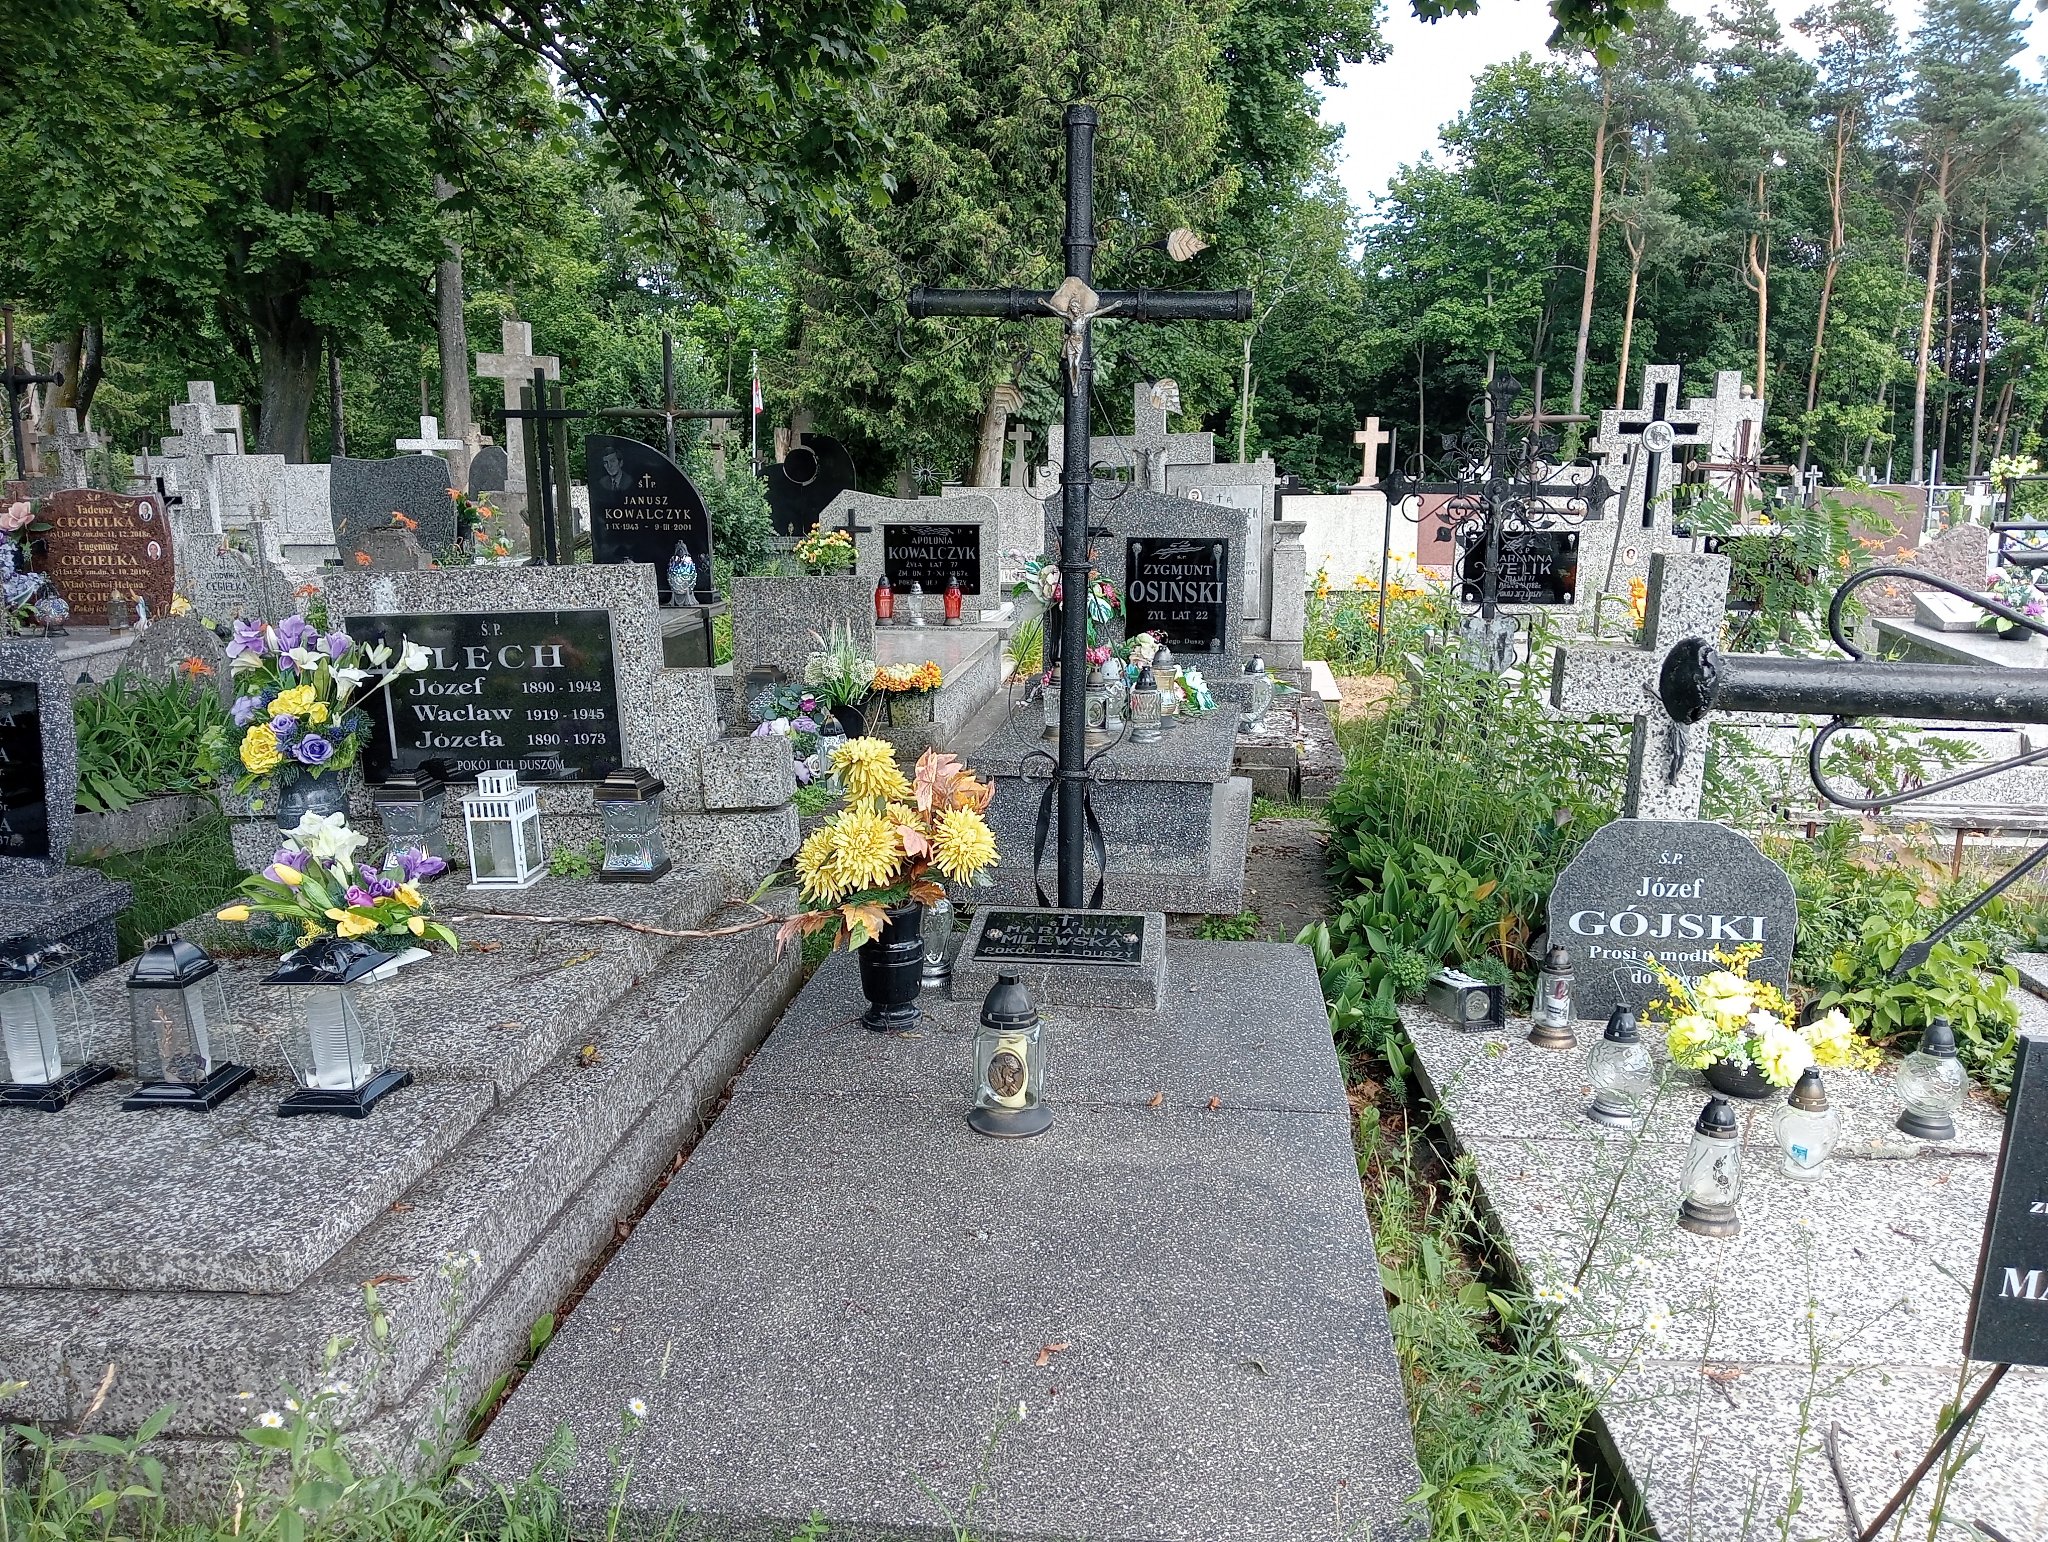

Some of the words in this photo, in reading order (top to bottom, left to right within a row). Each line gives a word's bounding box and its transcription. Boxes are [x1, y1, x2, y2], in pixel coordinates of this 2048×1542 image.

[624, 497, 668, 505] JANUSZ
[75, 504, 114, 515] Tadeusz
[605, 508, 691, 520] KOWALCZYK
[911, 536, 953, 545] APOLONIA
[78, 542, 119, 553] Eugeniusz
[888, 546, 976, 560] KOWALCZYK
[61, 555, 139, 567] CEGIEŁKA
[1498, 554, 1553, 563] ARIANNA
[1143, 564, 1214, 576] ZYGMUNT
[1129, 576, 1225, 604] OSIŃSKI
[1172, 610, 1191, 620] LAT
[1195, 610, 1209, 620] 22
[1184, 637, 1205, 646] Duszy
[432, 644, 565, 672] LECH
[409, 676, 487, 696] Józef
[521, 681, 555, 694] 1890
[568, 680, 602, 693] 1942
[526, 709, 559, 721] 1919
[572, 708, 605, 720] 1945
[415, 729, 505, 748] Józefa
[527, 733, 560, 746] 1890
[573, 733, 607, 745] 1973
[495, 759, 514, 770] ICH
[519, 759, 565, 770] DUSZOM
[1636, 876, 1705, 899] Józef
[1568, 904, 1768, 942] GÓJSKI
[1005, 925, 1123, 937] MARIANNA
[1000, 934, 1121, 948] MILEWSKA
[1082, 950, 1135, 958] DUSZY
[1589, 945, 1638, 960] Prosi
[1631, 970, 1652, 984] do
